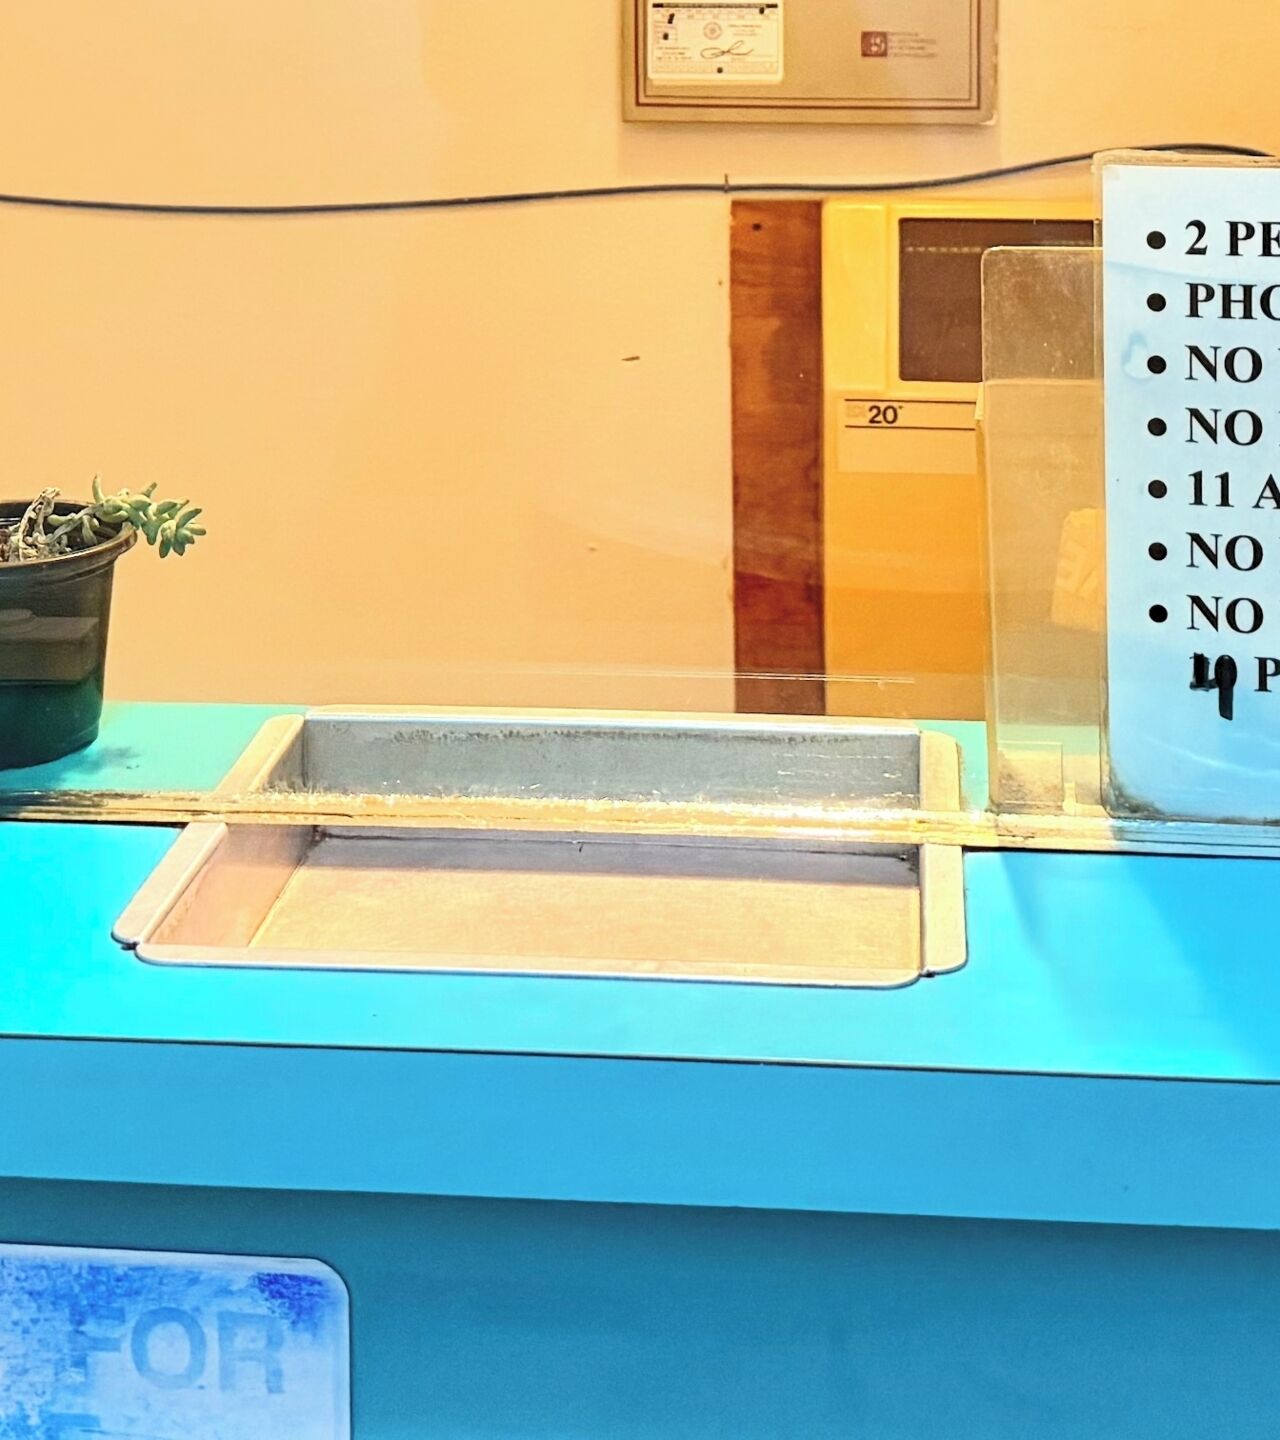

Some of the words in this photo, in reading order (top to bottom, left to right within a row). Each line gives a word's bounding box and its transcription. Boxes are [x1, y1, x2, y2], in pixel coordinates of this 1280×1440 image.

[1185, 219, 1208, 256] 2
[1185, 345, 1263, 383] NO
[1185, 408, 1263, 446] NO
[1187, 470, 1234, 508] 11
[1185, 533, 1264, 572] NO
[1186, 595, 1264, 634] NO
